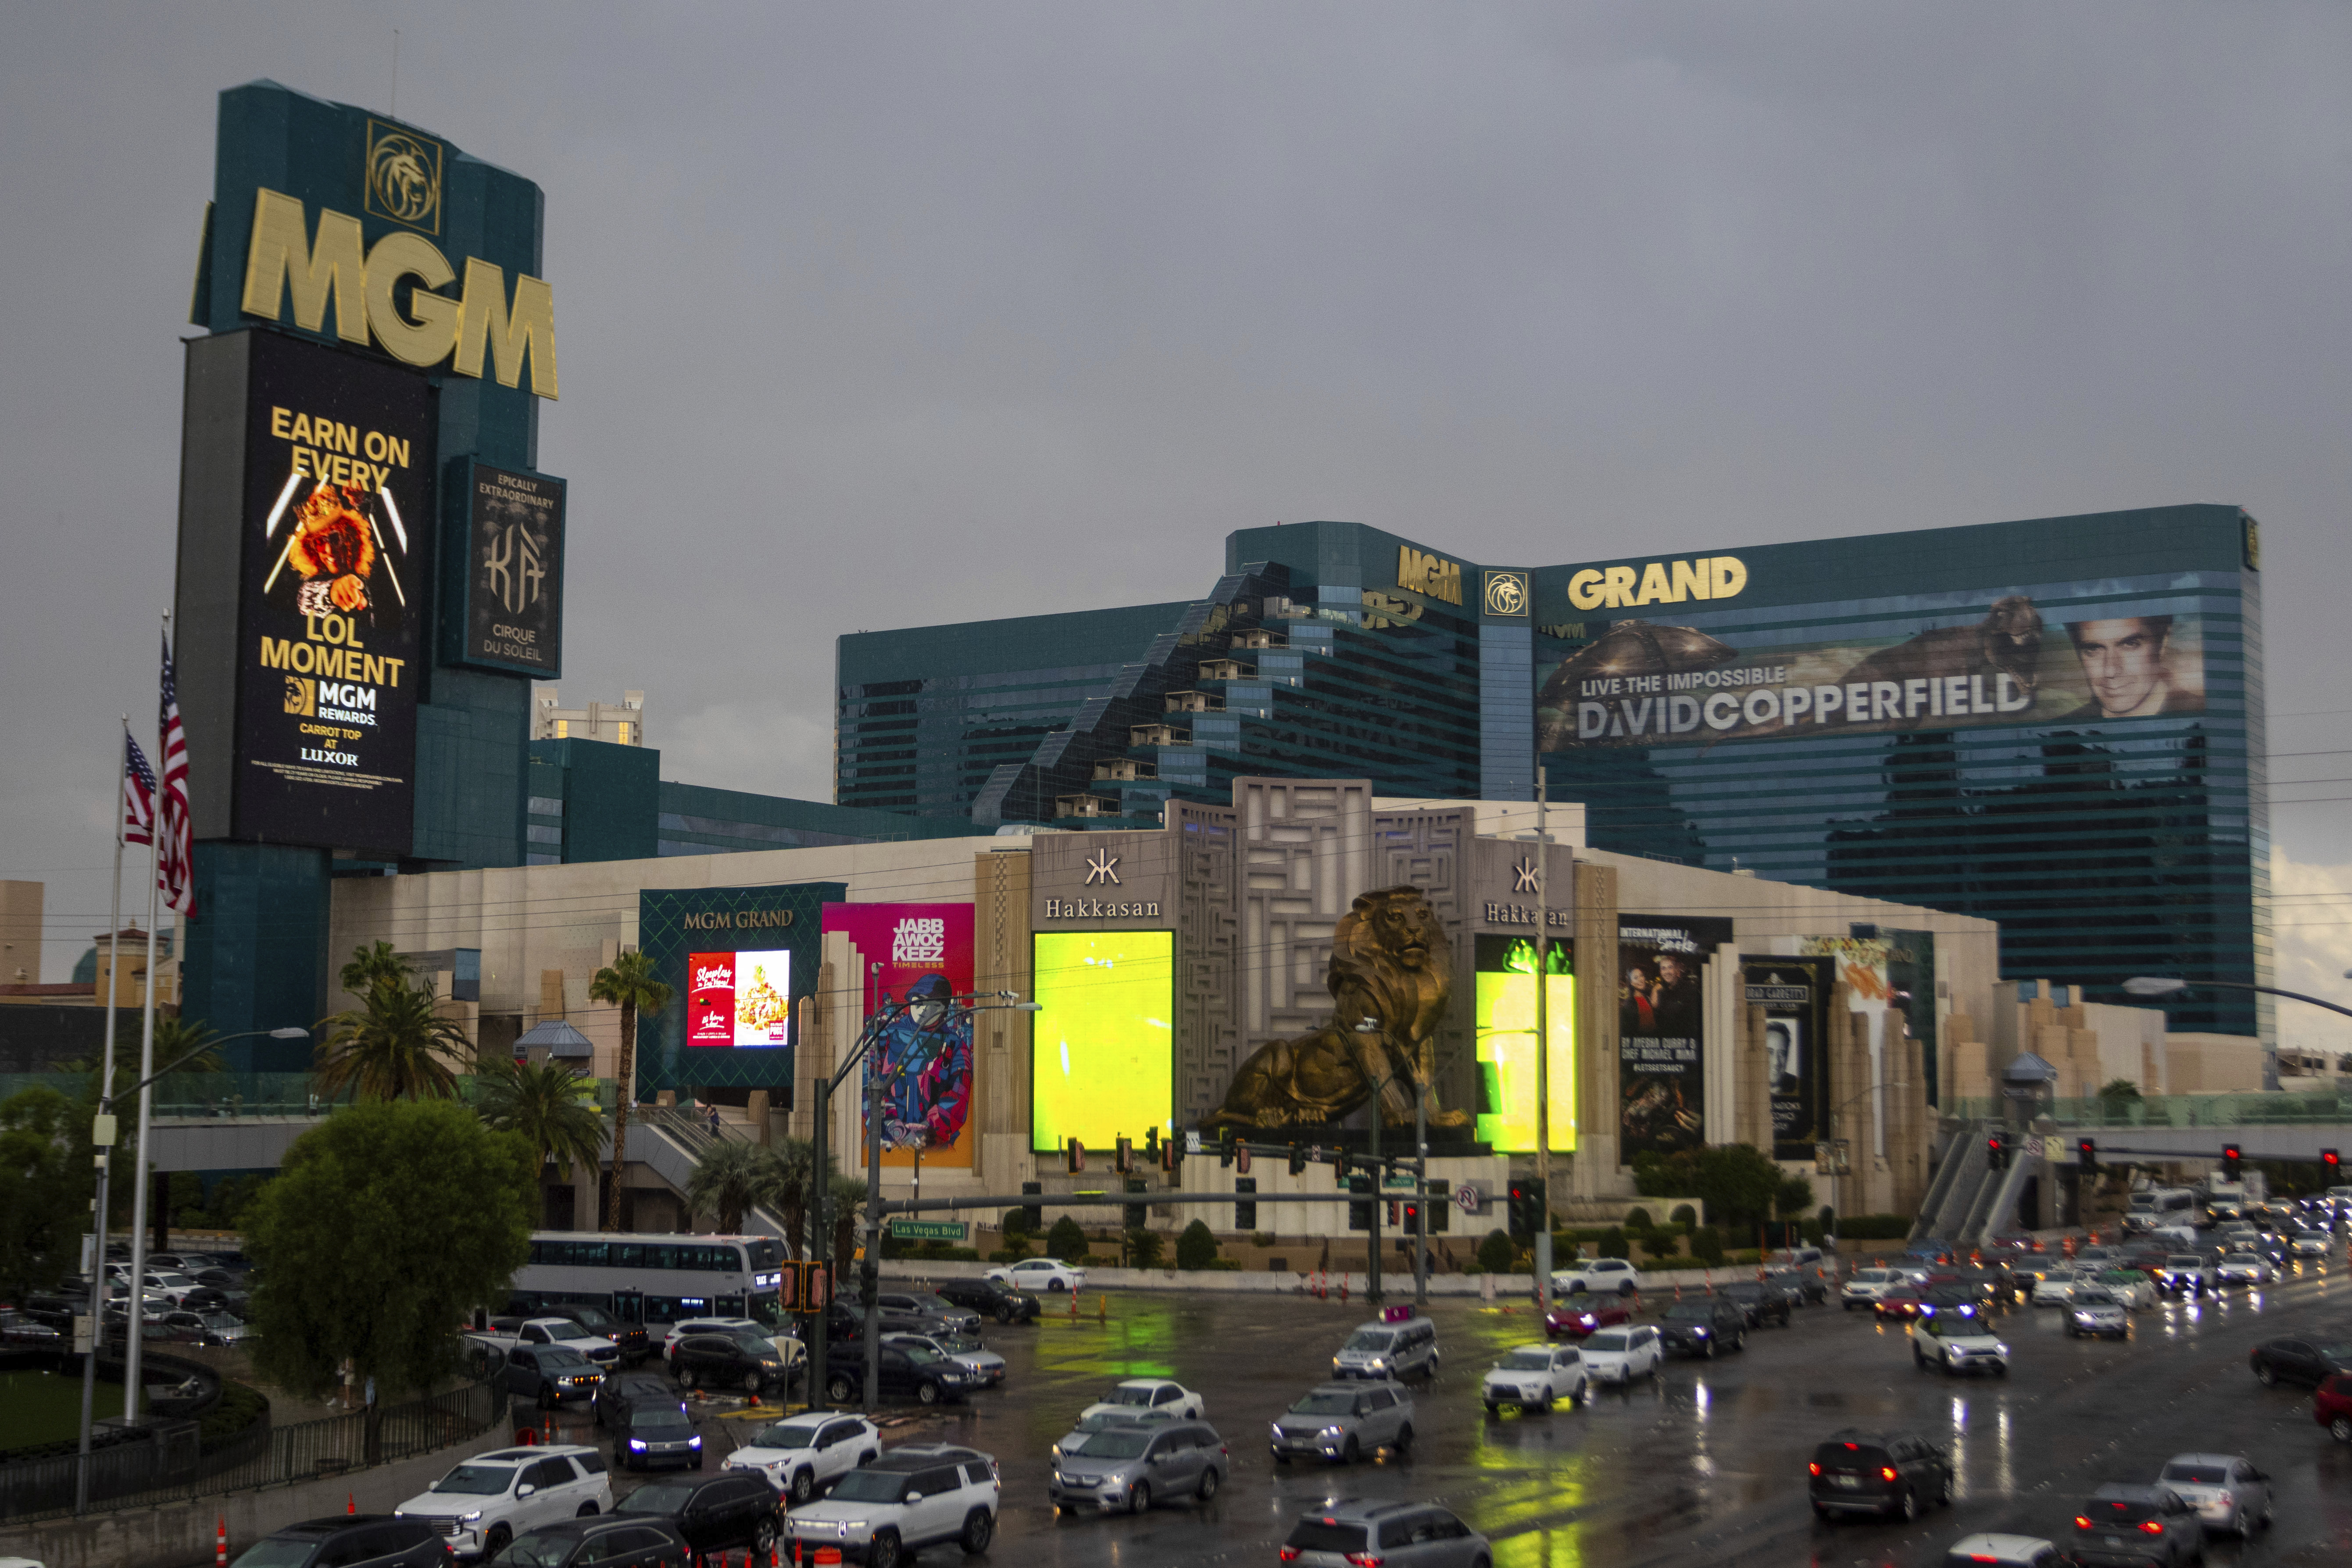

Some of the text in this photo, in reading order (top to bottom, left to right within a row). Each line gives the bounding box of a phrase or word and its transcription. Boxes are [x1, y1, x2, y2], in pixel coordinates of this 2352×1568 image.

[241, 187, 558, 400] MGM
[271, 405, 410, 468] EARN ON
[292, 445, 391, 494] EVERY
[498, 474, 537, 493] EPICALLY
[479, 483, 554, 509] EXTRAORDINARY
[1398, 545, 1462, 606] MGM
[1568, 557, 1747, 610] GRAND
[307, 611, 364, 648] LOL
[493, 624, 536, 644] CIRQUE
[484, 639, 542, 661] DU SOLEIL
[261, 636, 405, 687] MOMENT
[1581, 666, 1786, 696] LIVE THE IMPOSSIBLE
[319, 680, 376, 711] MGM
[318, 707, 376, 726] REWARDS
[300, 723, 362, 740] CARROT TOP
[324, 739, 338, 749] AT
[300, 748, 358, 766] LUXOR
[1045, 899, 1159, 917] Hakkasan
[1486, 903, 1568, 925] Hakkaan
[684, 910, 793, 929] MGM GRAND
[893, 918, 944, 933] JABB
[893, 933, 944, 947] AWOC
[893, 947, 944, 961] KEEZ
[697, 964, 732, 981] Sleepless
[896, 1224, 961, 1237] Las Vegas Blvd
